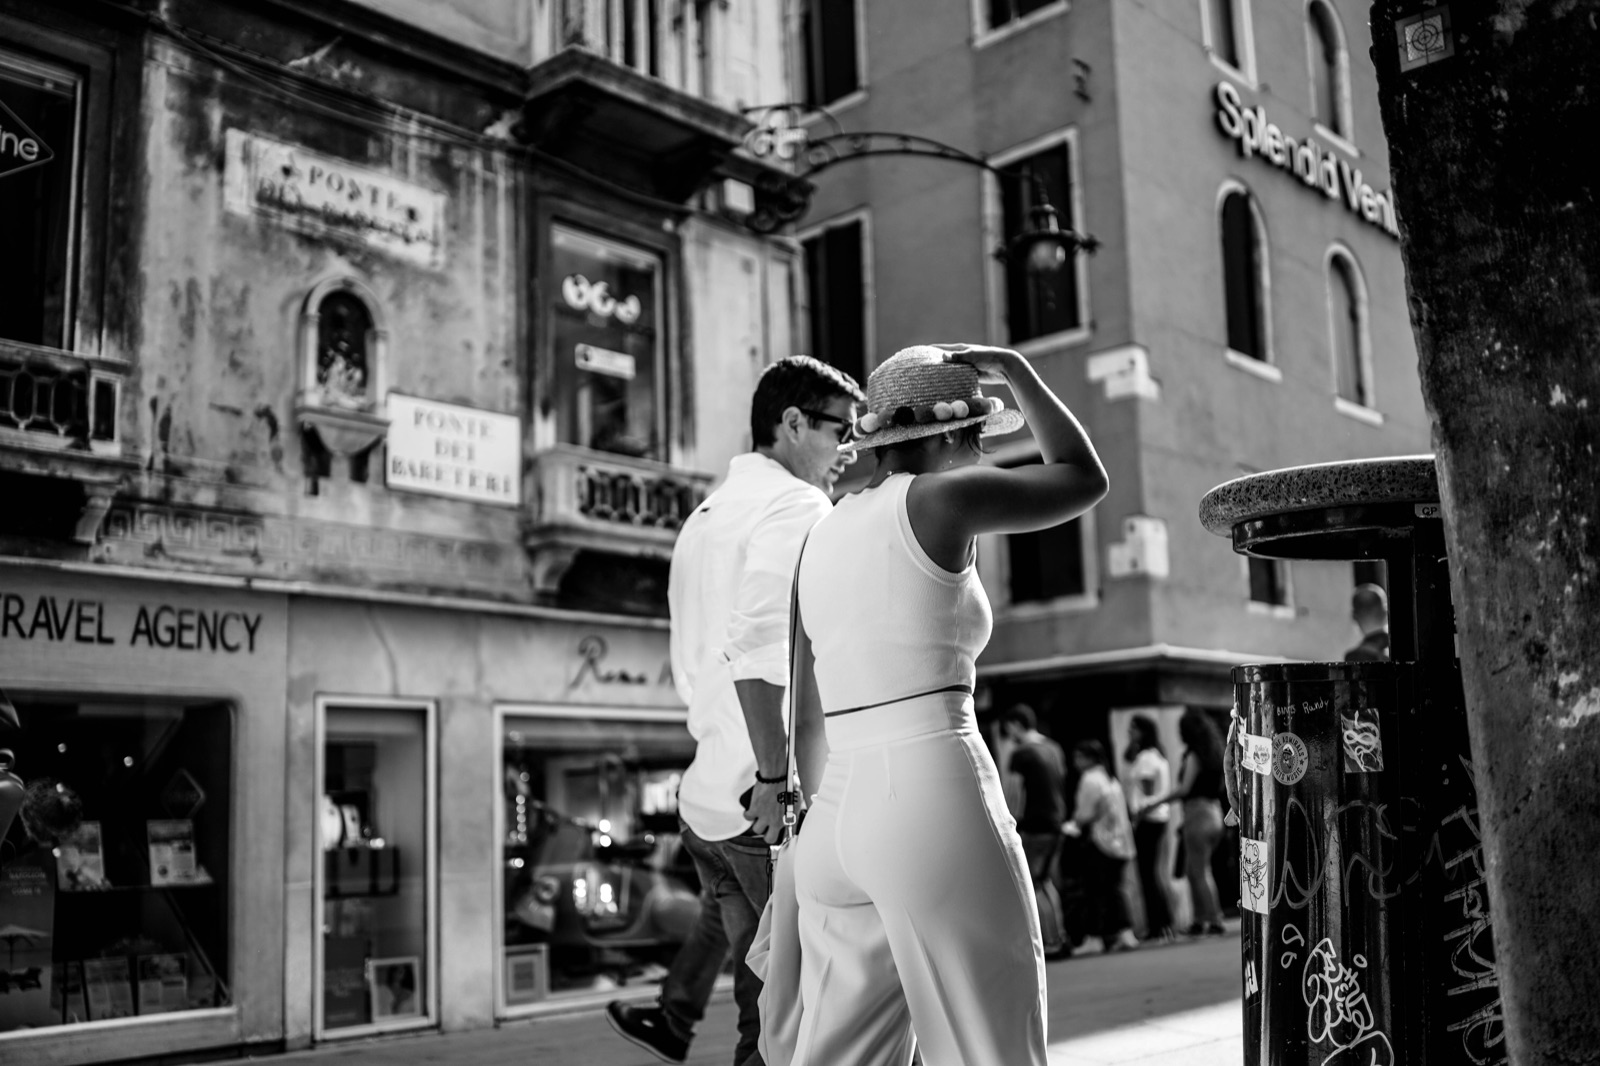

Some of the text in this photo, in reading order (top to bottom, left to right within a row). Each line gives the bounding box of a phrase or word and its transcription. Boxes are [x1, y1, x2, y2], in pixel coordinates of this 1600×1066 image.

[1217, 81, 1340, 199] Splendid
[414, 406, 490, 438] PONTE
[435, 436, 475, 463] DEI
[0, 592, 263, 654] RAVEL AGENCY
[1302, 697, 1329, 714] Randy
